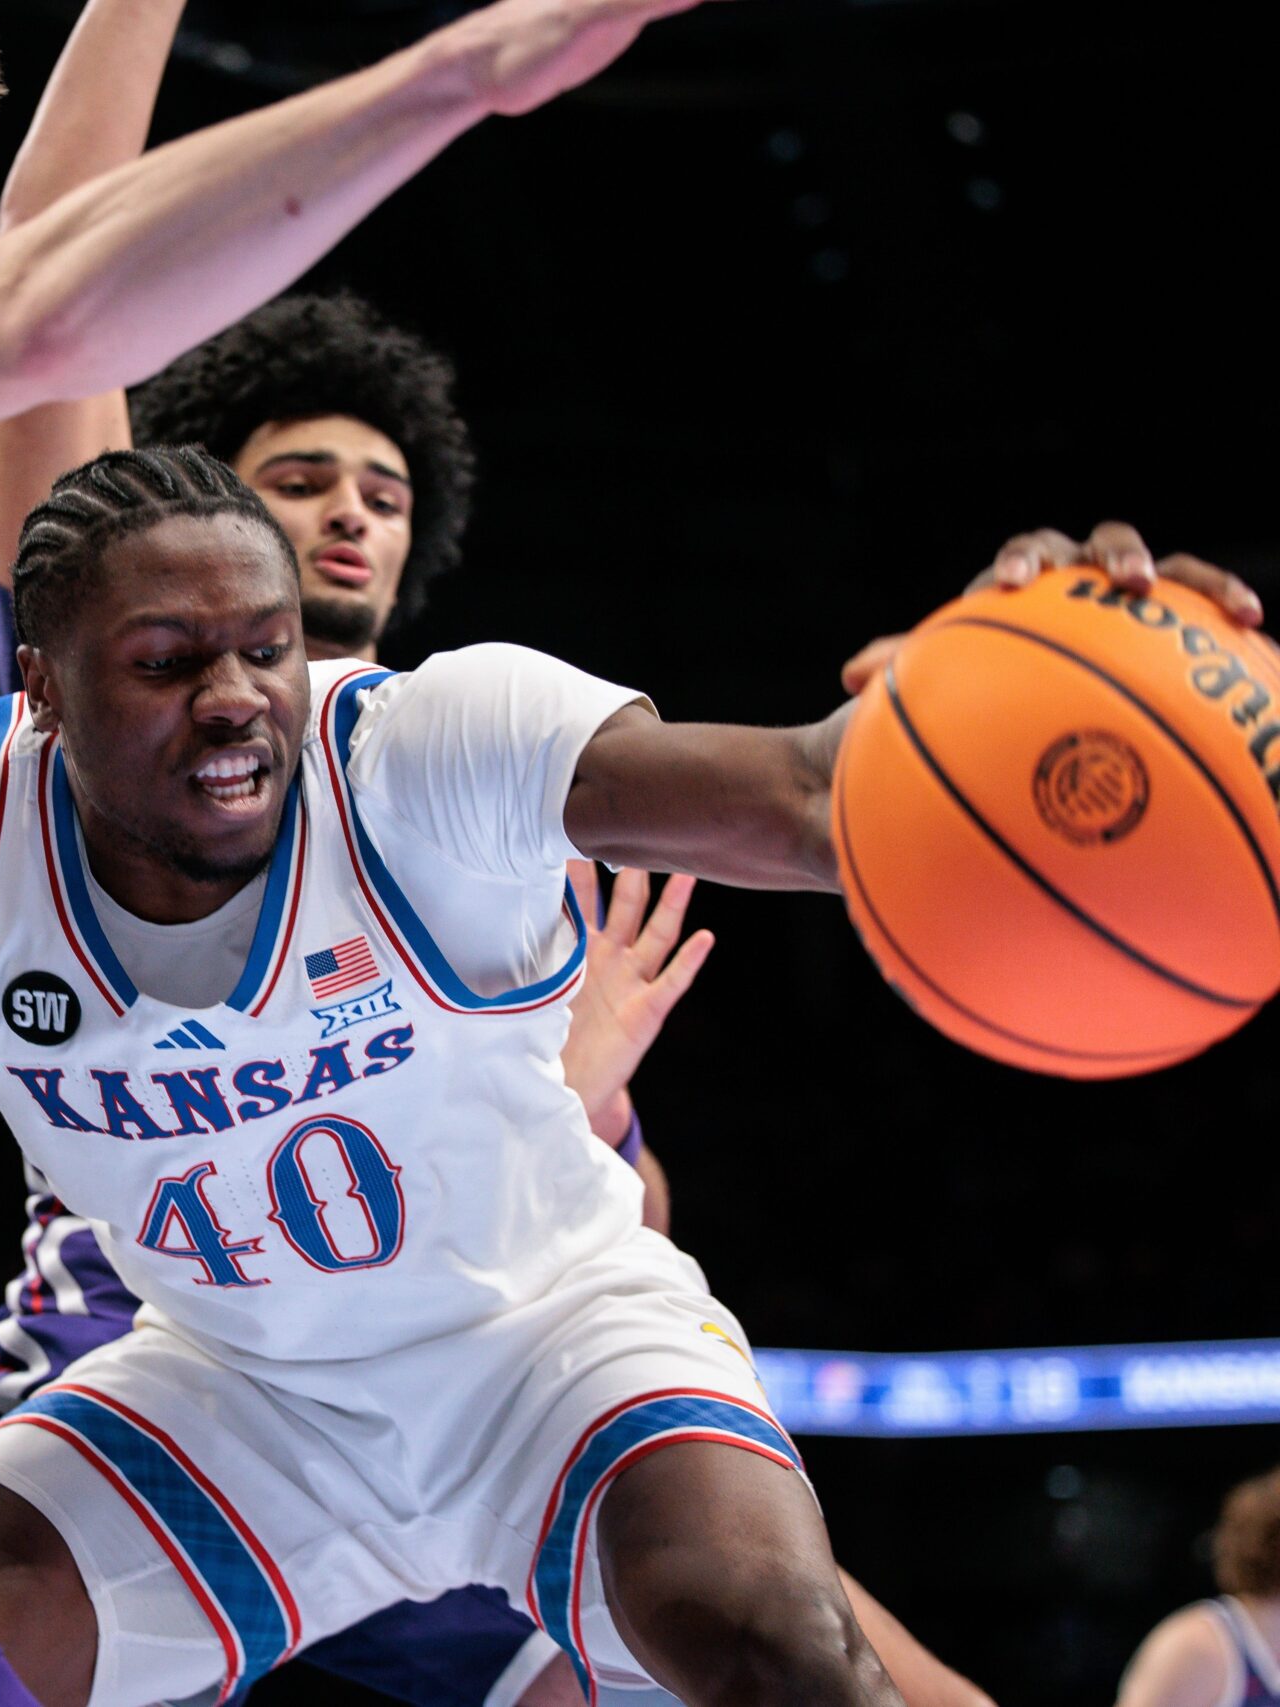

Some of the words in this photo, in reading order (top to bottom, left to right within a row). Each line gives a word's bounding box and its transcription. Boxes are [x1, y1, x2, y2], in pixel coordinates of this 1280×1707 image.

[11, 989, 70, 1033] SW
[6, 1023, 415, 1140] KANSAS
[136, 1113, 405, 1288] 40
